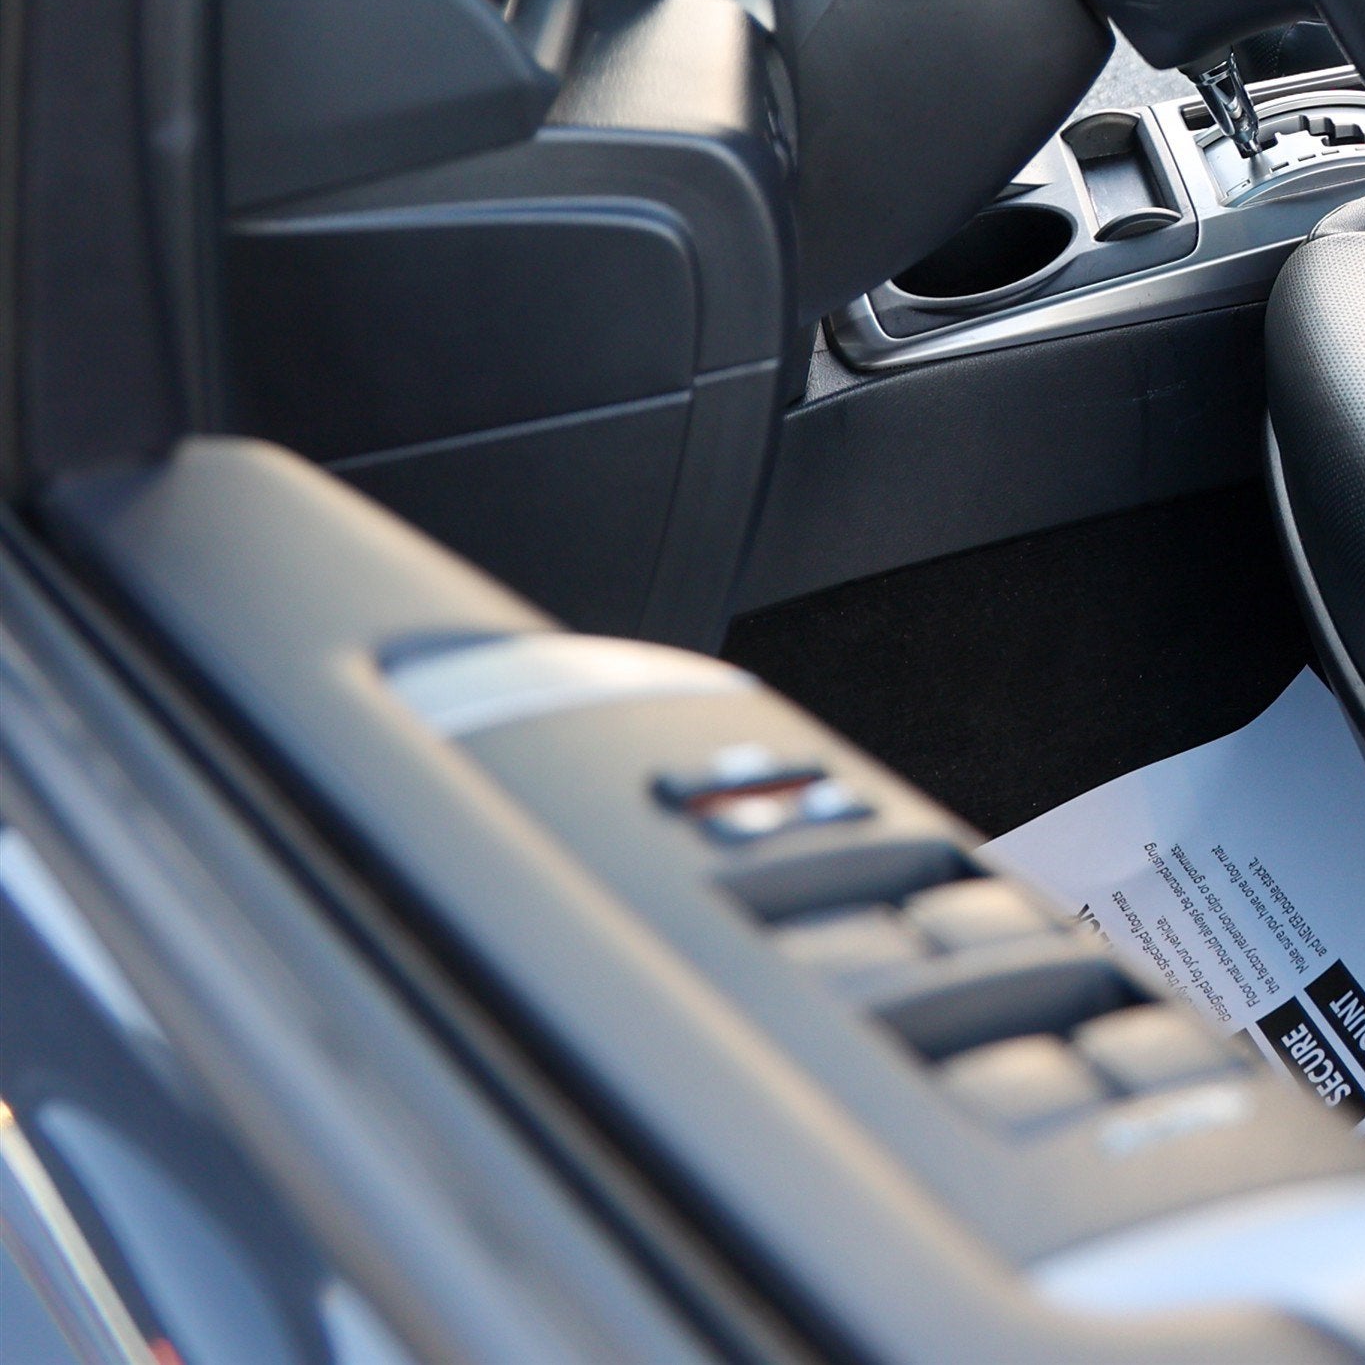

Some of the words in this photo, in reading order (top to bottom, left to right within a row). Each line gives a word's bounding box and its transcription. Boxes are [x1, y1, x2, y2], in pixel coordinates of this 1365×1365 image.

[1142, 841, 1165, 868] using
[1170, 842, 1206, 884] grommets.
[1210, 843, 1229, 863] mat
[1154, 865, 1186, 898] secured
[1222, 860, 1243, 883] floor
[1251, 864, 1275, 888] stack
[1196, 883, 1210, 894] or
[1237, 879, 1254, 898] one
[1269, 884, 1295, 915] double
[1111, 890, 1131, 912] mats
[1179, 895, 1194, 912] be
[1204, 892, 1223, 913] clips
[1249, 895, 1269, 920] have
[1124, 910, 1144, 933] floor
[1155, 914, 1182, 949] vehicle.
[1187, 907, 1213, 938] always
[1217, 911, 1249, 950] retention
[1263, 914, 1284, 934] you
[1287, 910, 1315, 944] NEVER
[1134, 930, 1170, 970] specified
[1203, 935, 1233, 966] should
[1275, 929, 1294, 951] sure
[1306, 937, 1327, 957] and
[1175, 947, 1199, 969] your
[1242, 947, 1269, 980] factory
[1288, 946, 1309, 974] Make
[1164, 969, 1180, 987] the
[1188, 967, 1204, 983] for
[1225, 963, 1245, 983] mat
[1263, 975, 1280, 995] the
[1194, 979, 1232, 1022] designed
[1238, 982, 1260, 1008] Floor
[1281, 1023, 1351, 1107] SECURE
